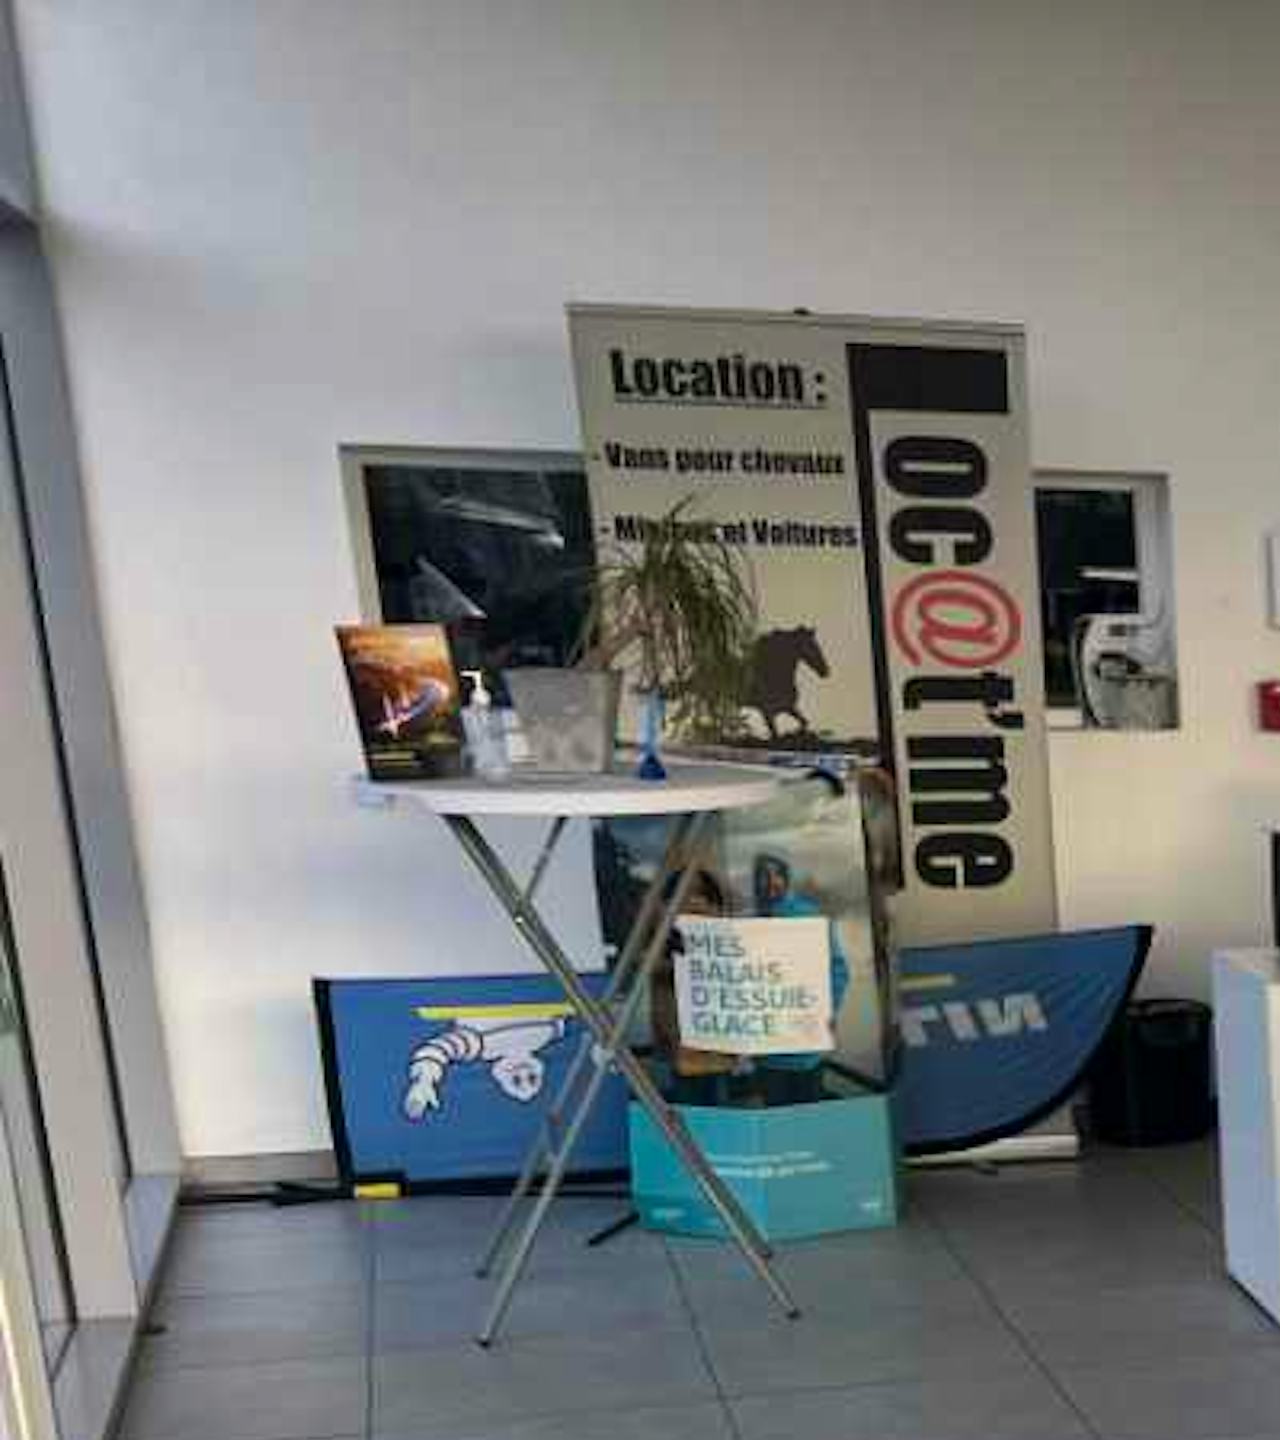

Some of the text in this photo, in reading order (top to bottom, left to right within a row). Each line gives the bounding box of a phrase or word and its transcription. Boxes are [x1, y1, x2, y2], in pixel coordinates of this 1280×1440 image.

[610, 349, 803, 402] Location
[604, 442, 669, 471] Vans
[673, 447, 733, 473] pour
[739, 447, 844, 474] chevaux
[752, 518, 858, 547] Voitures
[690, 932, 746, 958] MES
